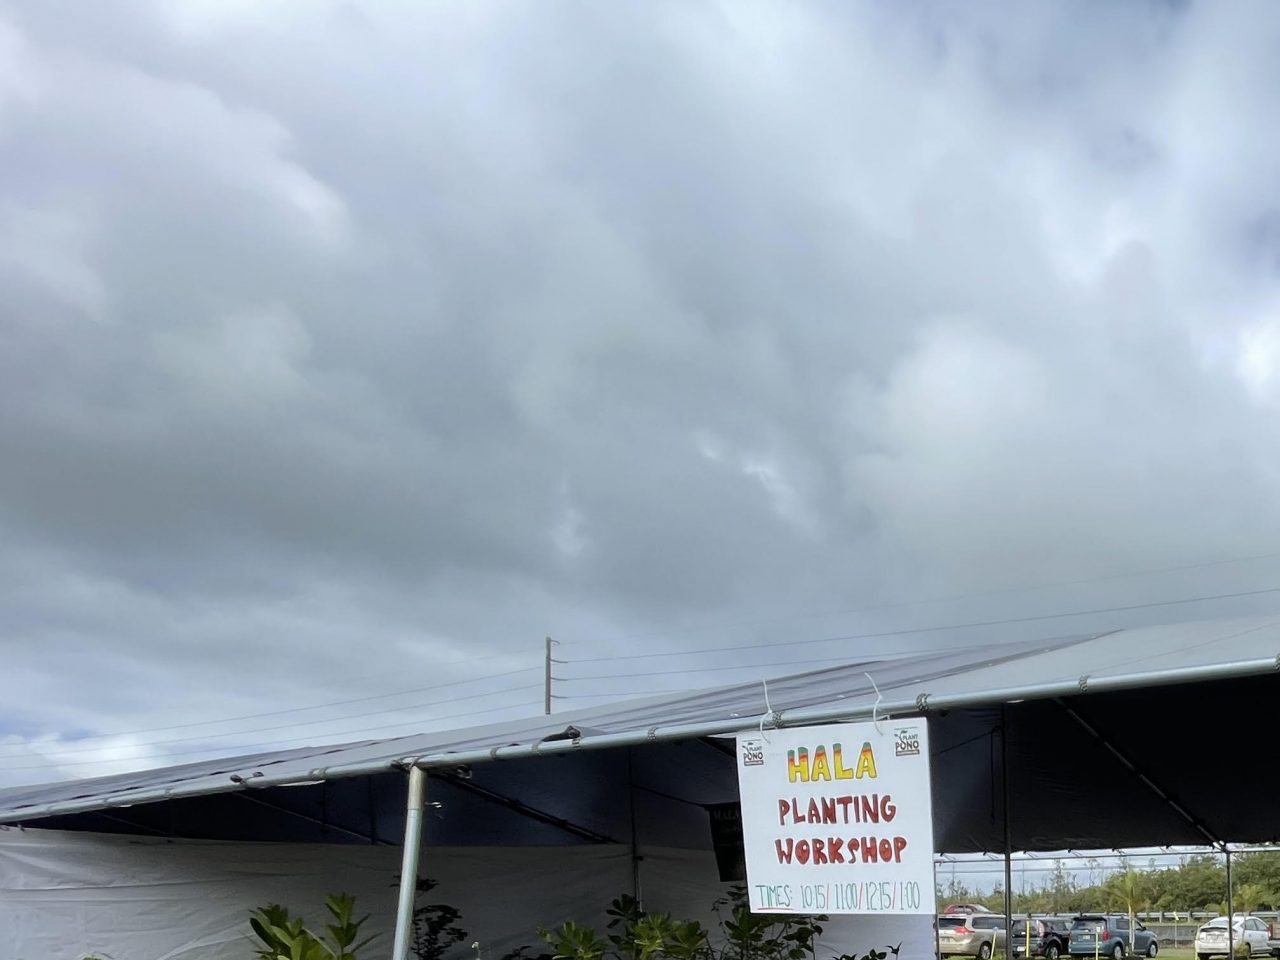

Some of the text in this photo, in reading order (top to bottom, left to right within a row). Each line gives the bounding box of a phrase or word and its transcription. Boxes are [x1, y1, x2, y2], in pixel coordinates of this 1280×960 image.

[743, 751, 763, 761] PONO
[895, 740, 919, 750] PONO
[787, 742, 877, 783] HALA
[778, 794, 896, 825] PLANTING
[774, 836, 907, 864] WORKSHOP
[755, 884, 793, 907] TIMES:
